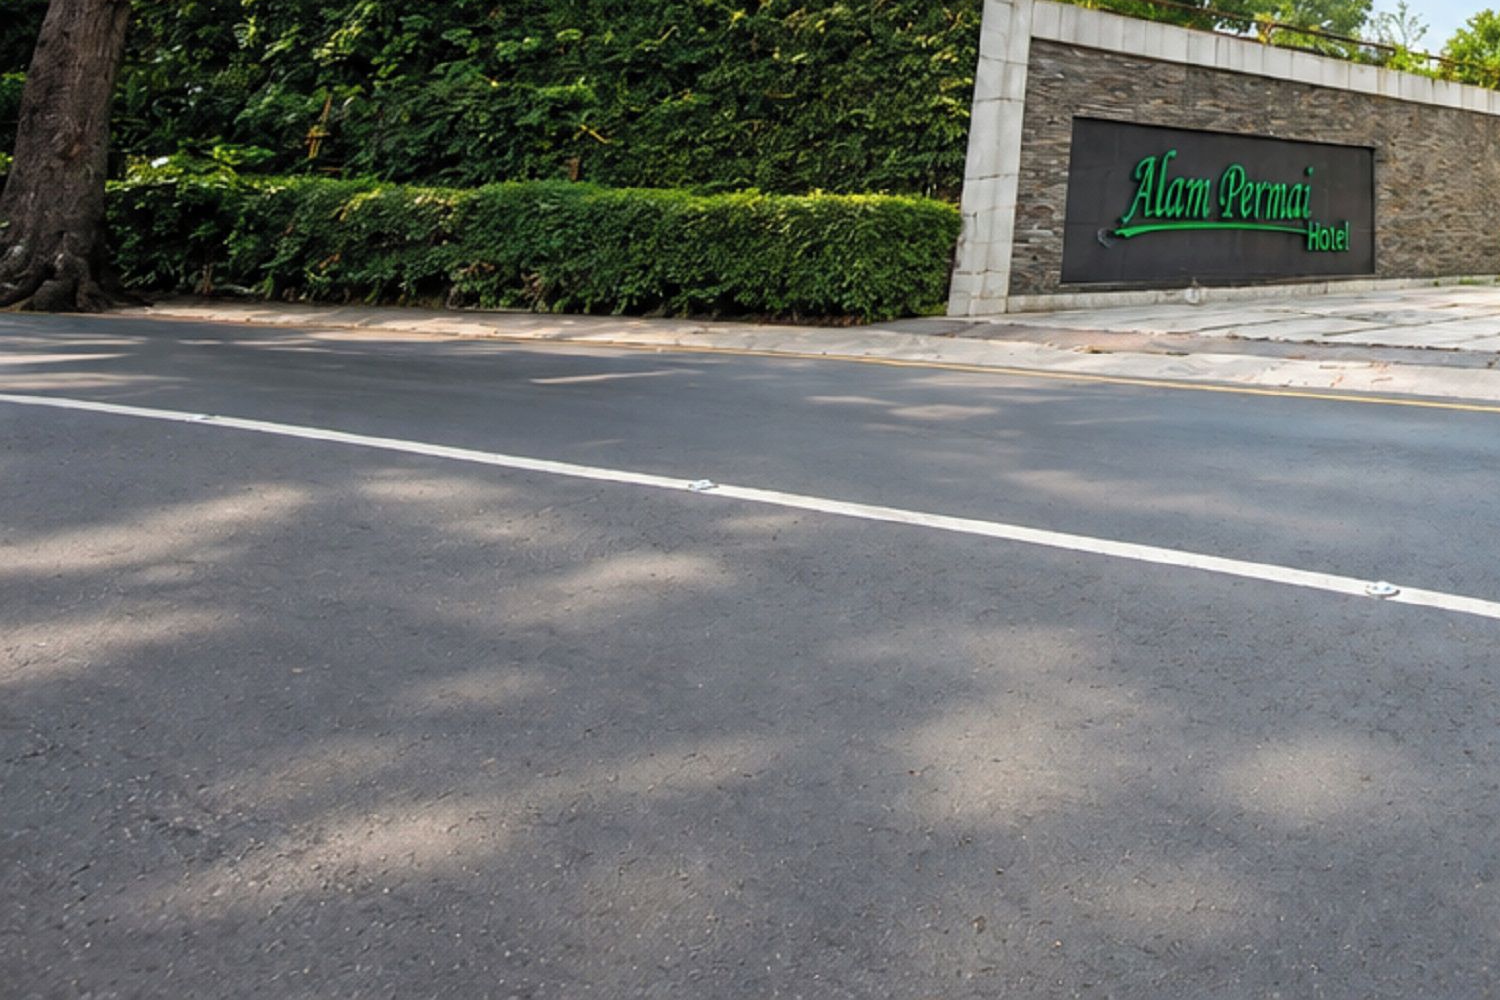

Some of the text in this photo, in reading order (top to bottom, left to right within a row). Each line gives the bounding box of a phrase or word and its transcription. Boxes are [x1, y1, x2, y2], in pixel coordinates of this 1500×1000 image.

[1121, 149, 1314, 223] Alam Permai
[1308, 220, 1350, 251] Hotel
